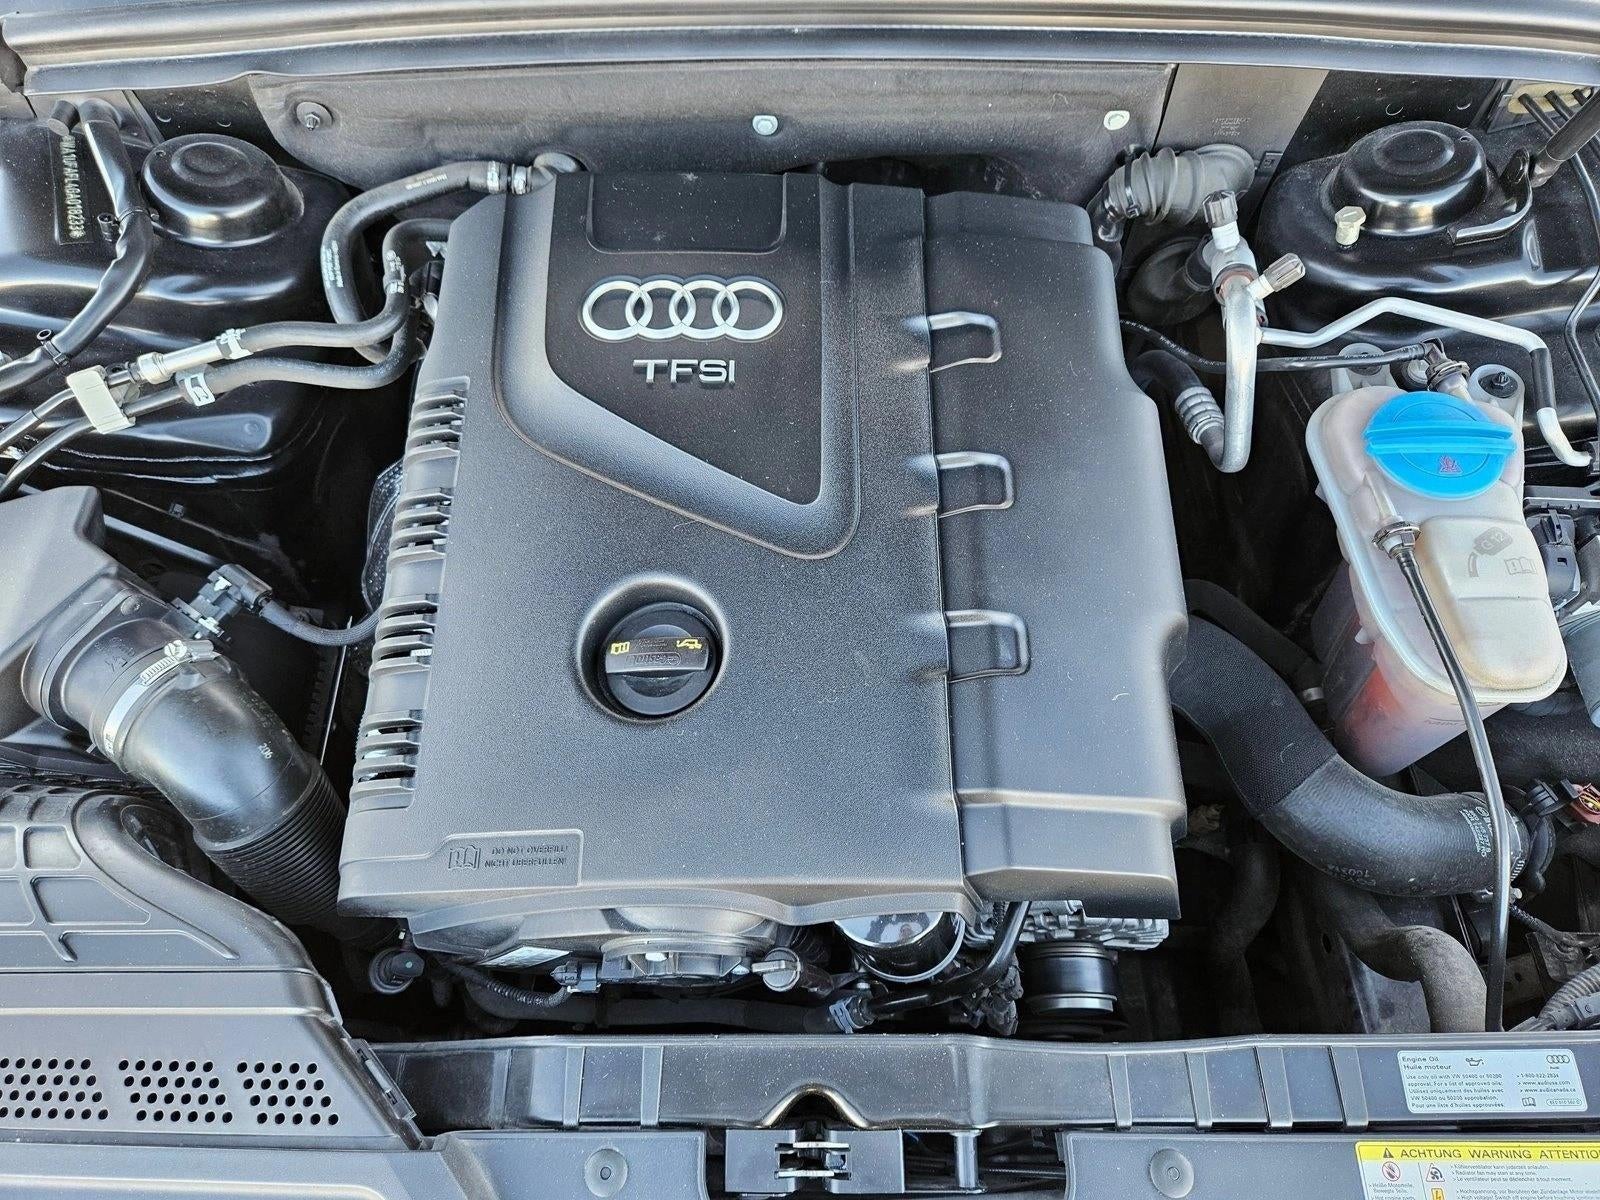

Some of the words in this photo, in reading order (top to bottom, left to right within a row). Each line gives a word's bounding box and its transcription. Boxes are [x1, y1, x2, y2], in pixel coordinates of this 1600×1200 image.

[633, 359, 736, 383] TFSI
[1401, 1056, 1427, 1064] Engine
[1400, 1148, 1462, 1159] ACHTUNG
[1468, 1148, 1532, 1159] WARNING
[1540, 1148, 1600, 1159] ATTENTIO
